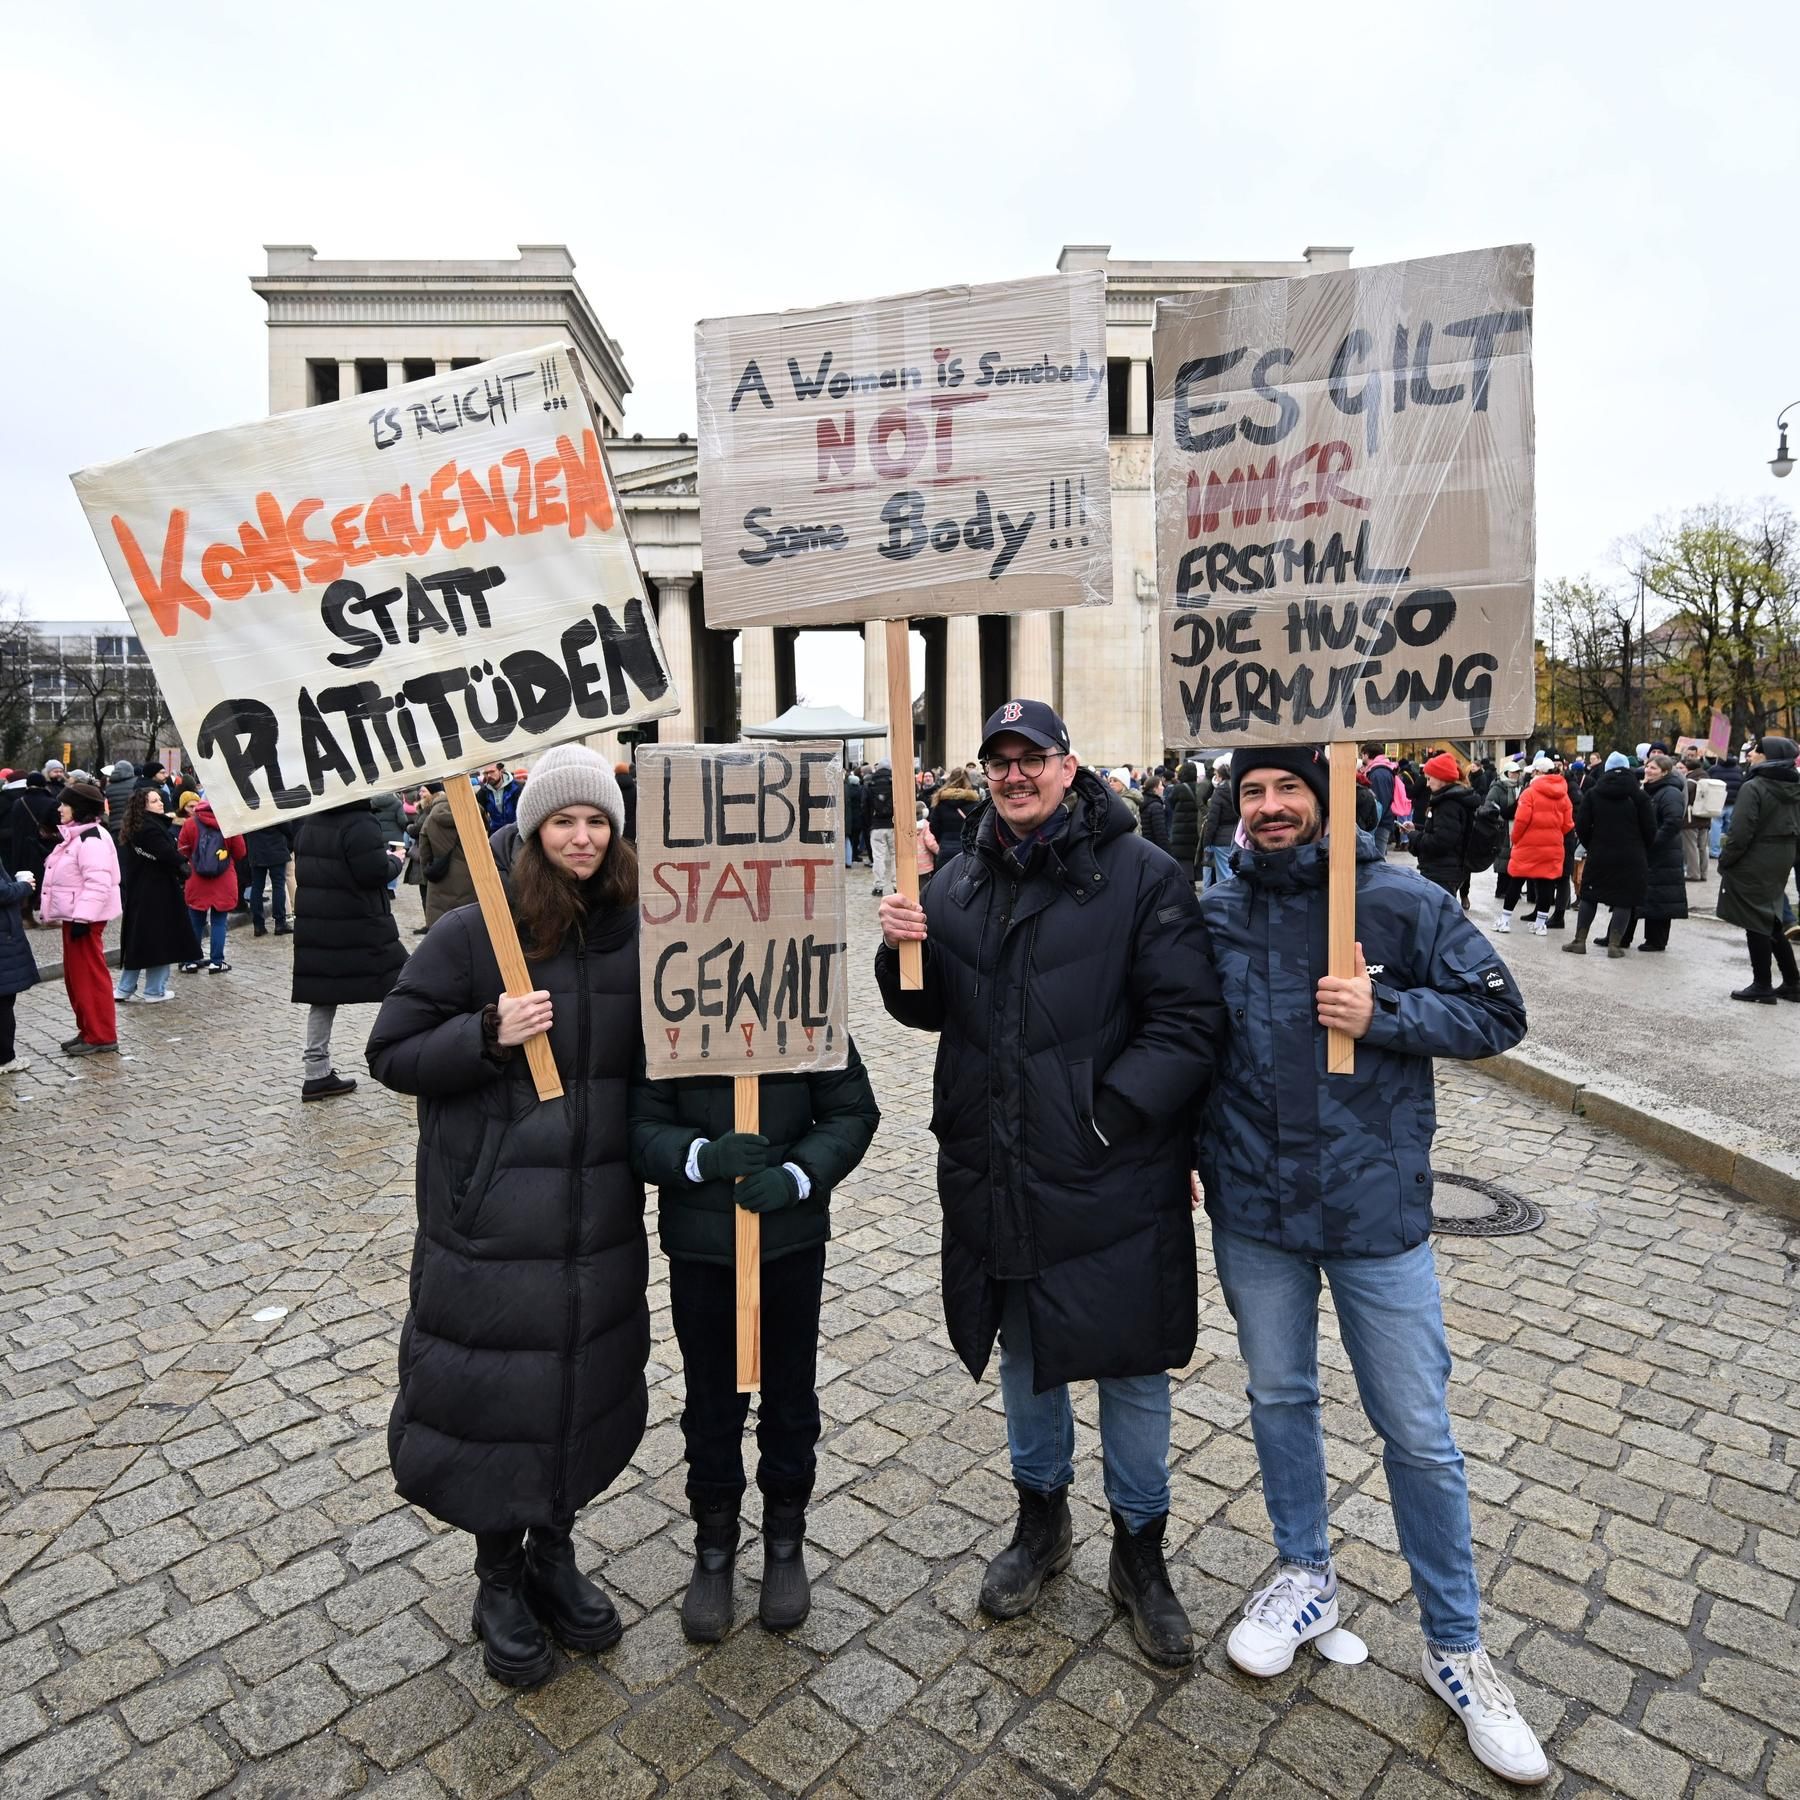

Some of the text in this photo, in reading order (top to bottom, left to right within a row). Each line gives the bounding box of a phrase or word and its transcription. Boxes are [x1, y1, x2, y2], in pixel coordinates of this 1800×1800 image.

[369, 407, 402, 450] ES
[406, 370, 536, 440] REICHT
[729, 347, 1106, 411] A Woman is Somebody
[1174, 311, 1532, 456] ES GILT
[816, 393, 989, 482] NOT
[111, 427, 615, 637] KONSEQUENZEN
[1186, 439, 1371, 539] IMMER
[738, 507, 849, 567] Some
[876, 490, 1037, 580] Body
[1176, 519, 1410, 610] ERSTMAL
[320, 566, 507, 669] STATT
[1171, 587, 1457, 667] DIE HUSO
[1002, 702, 1023, 724] B
[1179, 652, 1499, 738] VERMUTUNG
[663, 751, 837, 848] LIEBE
[642, 858, 834, 925] STATT
[653, 934, 847, 1033] GEWALT
